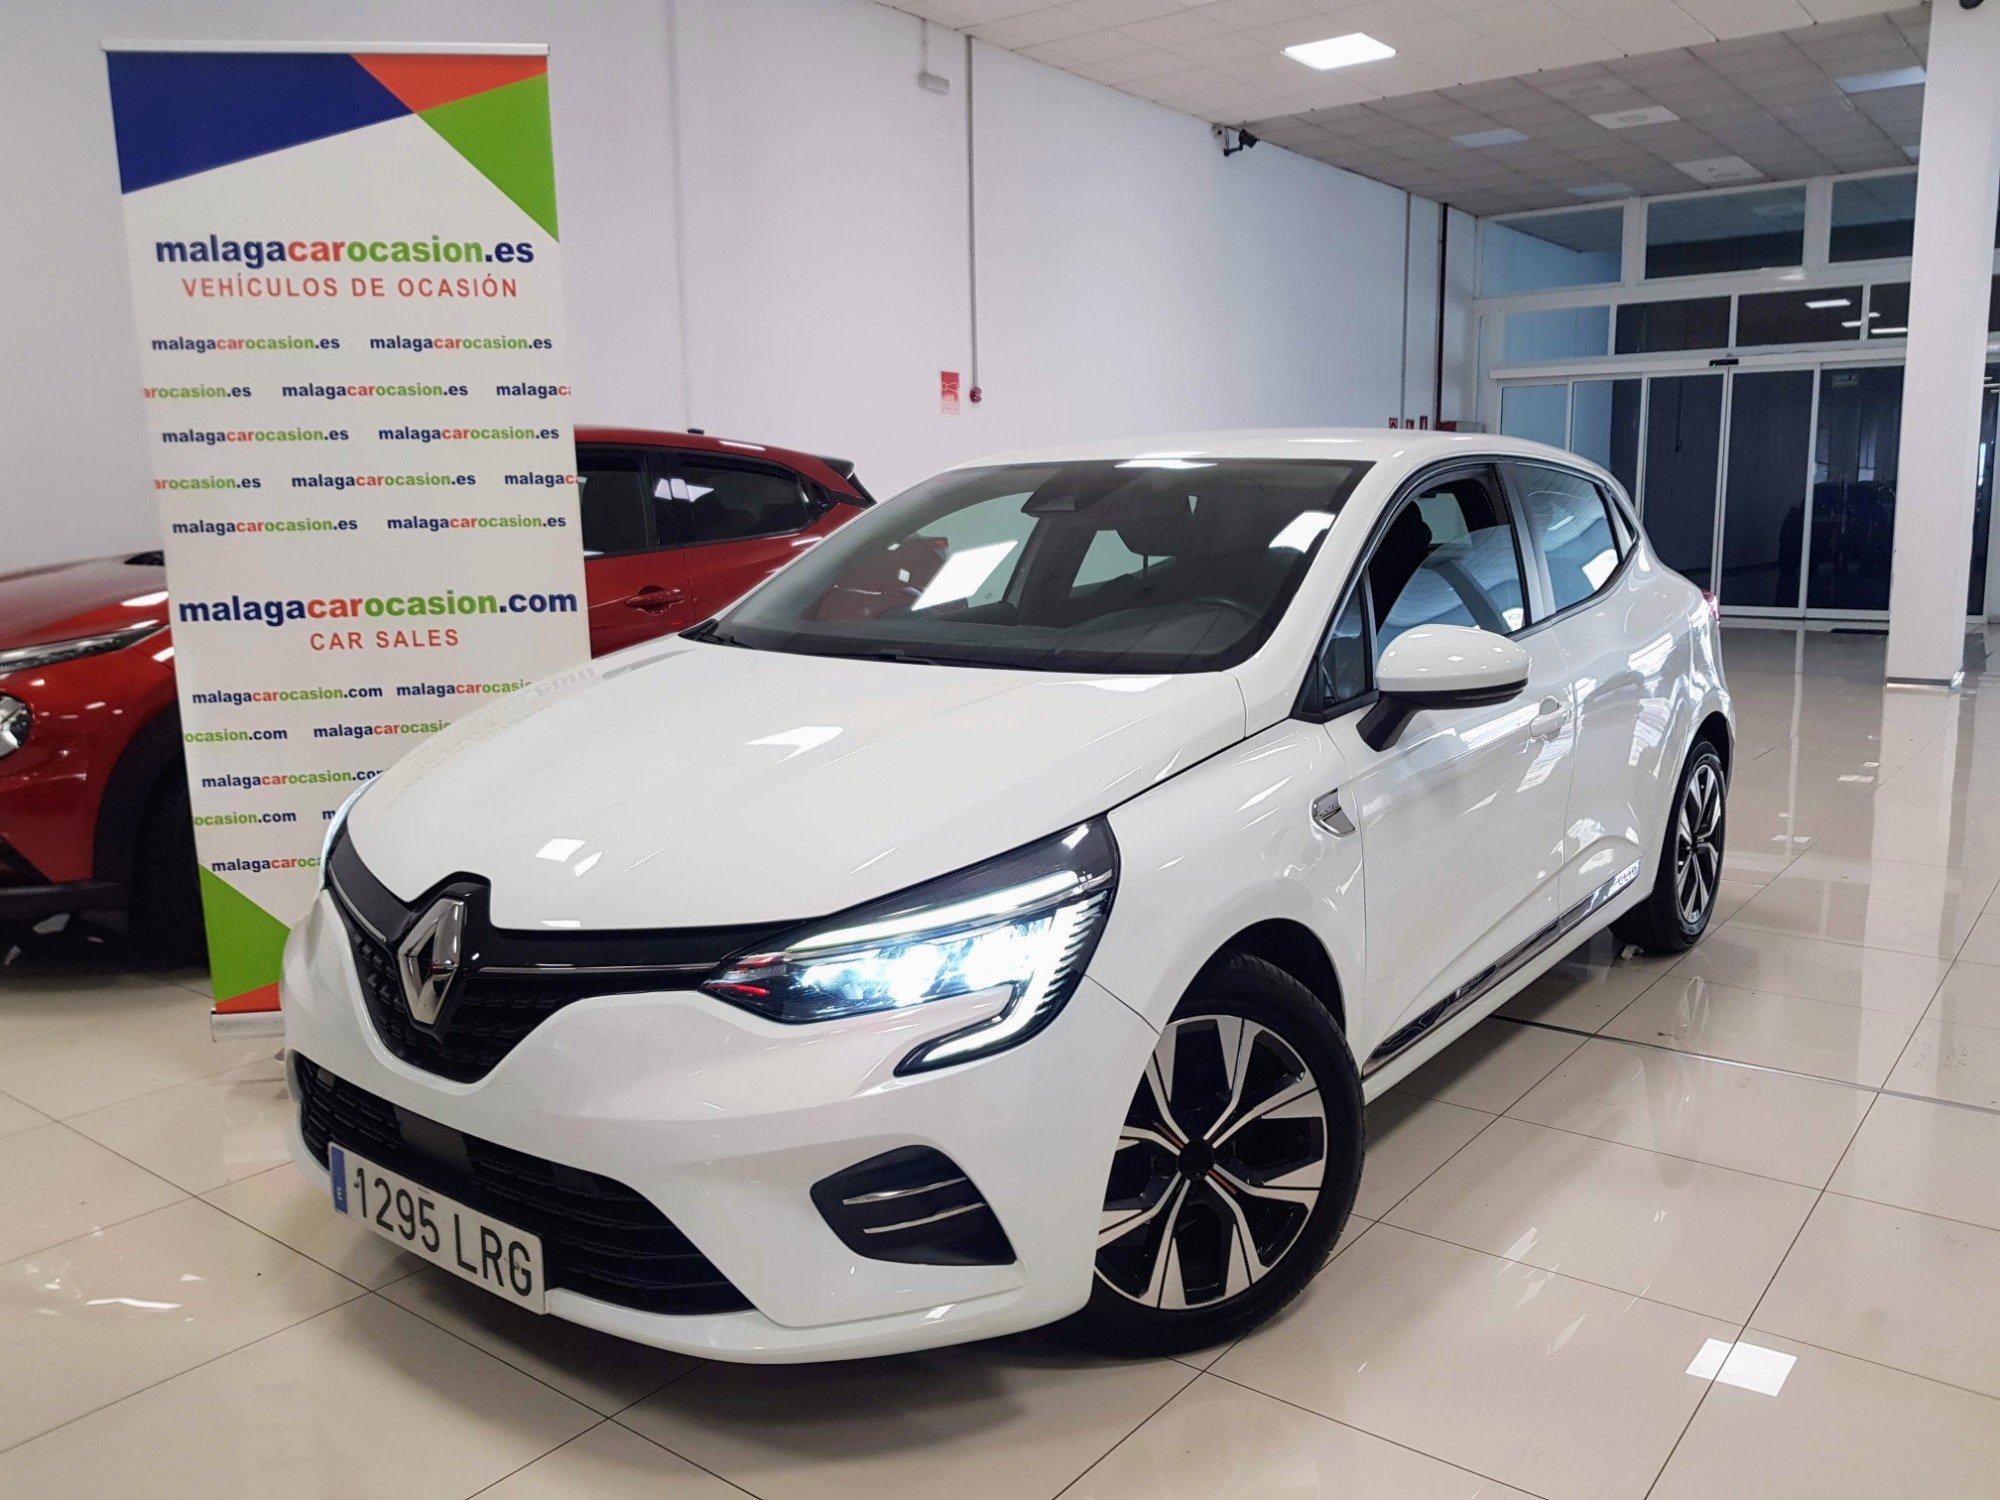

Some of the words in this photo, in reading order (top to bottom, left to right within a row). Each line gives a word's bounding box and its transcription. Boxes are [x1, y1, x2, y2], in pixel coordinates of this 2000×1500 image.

[155, 235, 535, 269] malagacarocasion.es
[182, 273, 338, 298] VEHÍCULOS
[351, 277, 386, 298] DE
[398, 272, 518, 298] OCASIÓN
[152, 337, 340, 353] malagacarocasion.es
[370, 335, 552, 351] malagacarocasion.es
[282, 383, 468, 399] malagacarocasion.es
[496, 382, 572, 399] malagac
[162, 428, 349, 445] malagacarocasion.es
[378, 426, 559, 443] malagacarocasion.es
[291, 473, 476, 490] malagacarocasion.es
[504, 471, 578, 488] malagac
[172, 518, 358, 535] malagacarocasion.es
[387, 514, 567, 531] malagacarocasion.es
[179, 590, 577, 626] malagacarocasion.com
[310, 632, 363, 650] CAR
[376, 628, 460, 648] SALES
[192, 686, 383, 705] malagacarocasion.com
[396, 679, 532, 698] malagacarocasi
[185, 728, 288, 743] ocasion.com
[194, 811, 296, 826] ocasion.com
[356, 1167, 440, 1253] 1295
[453, 1213, 533, 1297] LRG
